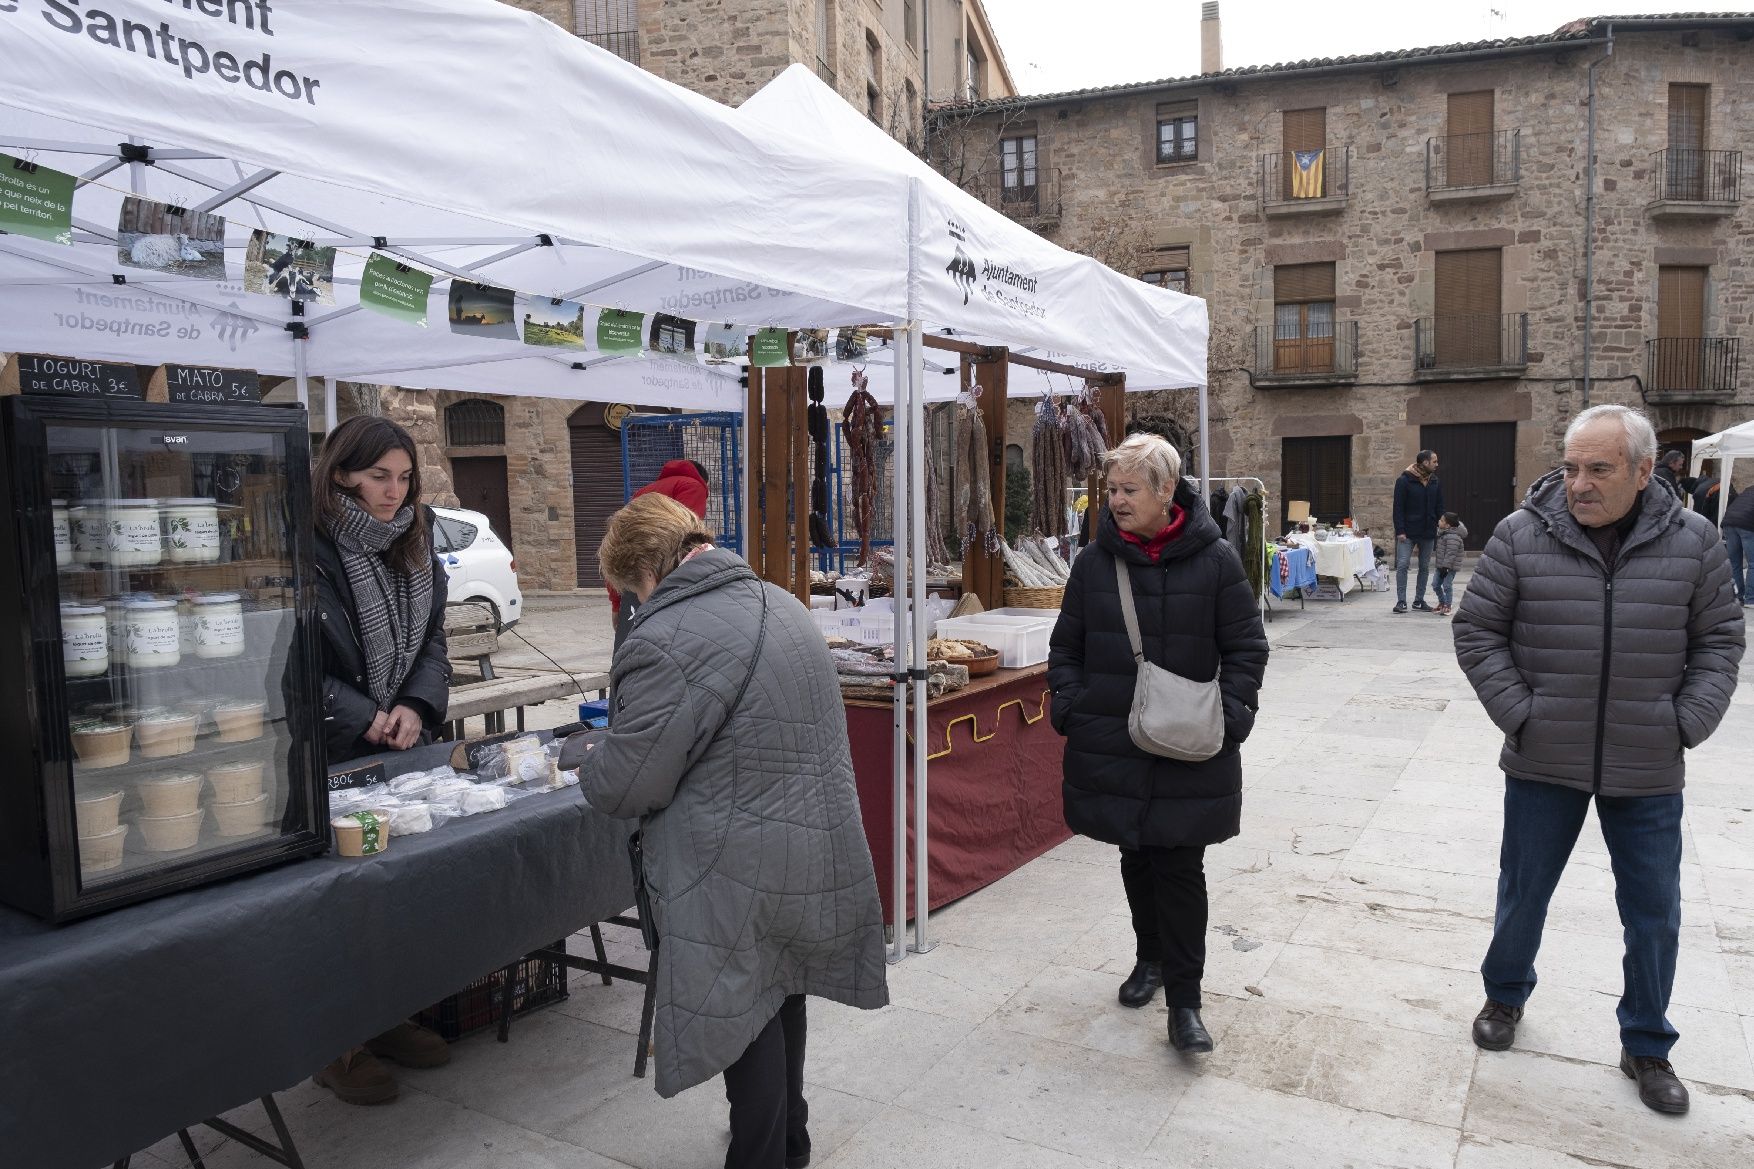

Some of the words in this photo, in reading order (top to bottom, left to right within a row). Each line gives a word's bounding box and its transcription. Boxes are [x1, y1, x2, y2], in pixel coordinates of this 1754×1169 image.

[42, 0, 320, 106] Santpedor
[38, 186, 50, 194] un
[3, 202, 18, 211] pel
[4, 189, 22, 198] que
[24, 195, 42, 205] neix
[43, 200, 56, 209] de
[57, 203, 65, 211] la
[982, 258, 1037, 293] Ajuntament
[981, 285, 997, 303] de
[33, 358, 102, 378] IOGURT
[32, 381, 48, 389] DE
[53, 379, 101, 393] CABRA
[108, 378, 128, 392] 3€
[176, 392, 186, 400] DE
[190, 390, 225, 402] CABRA
